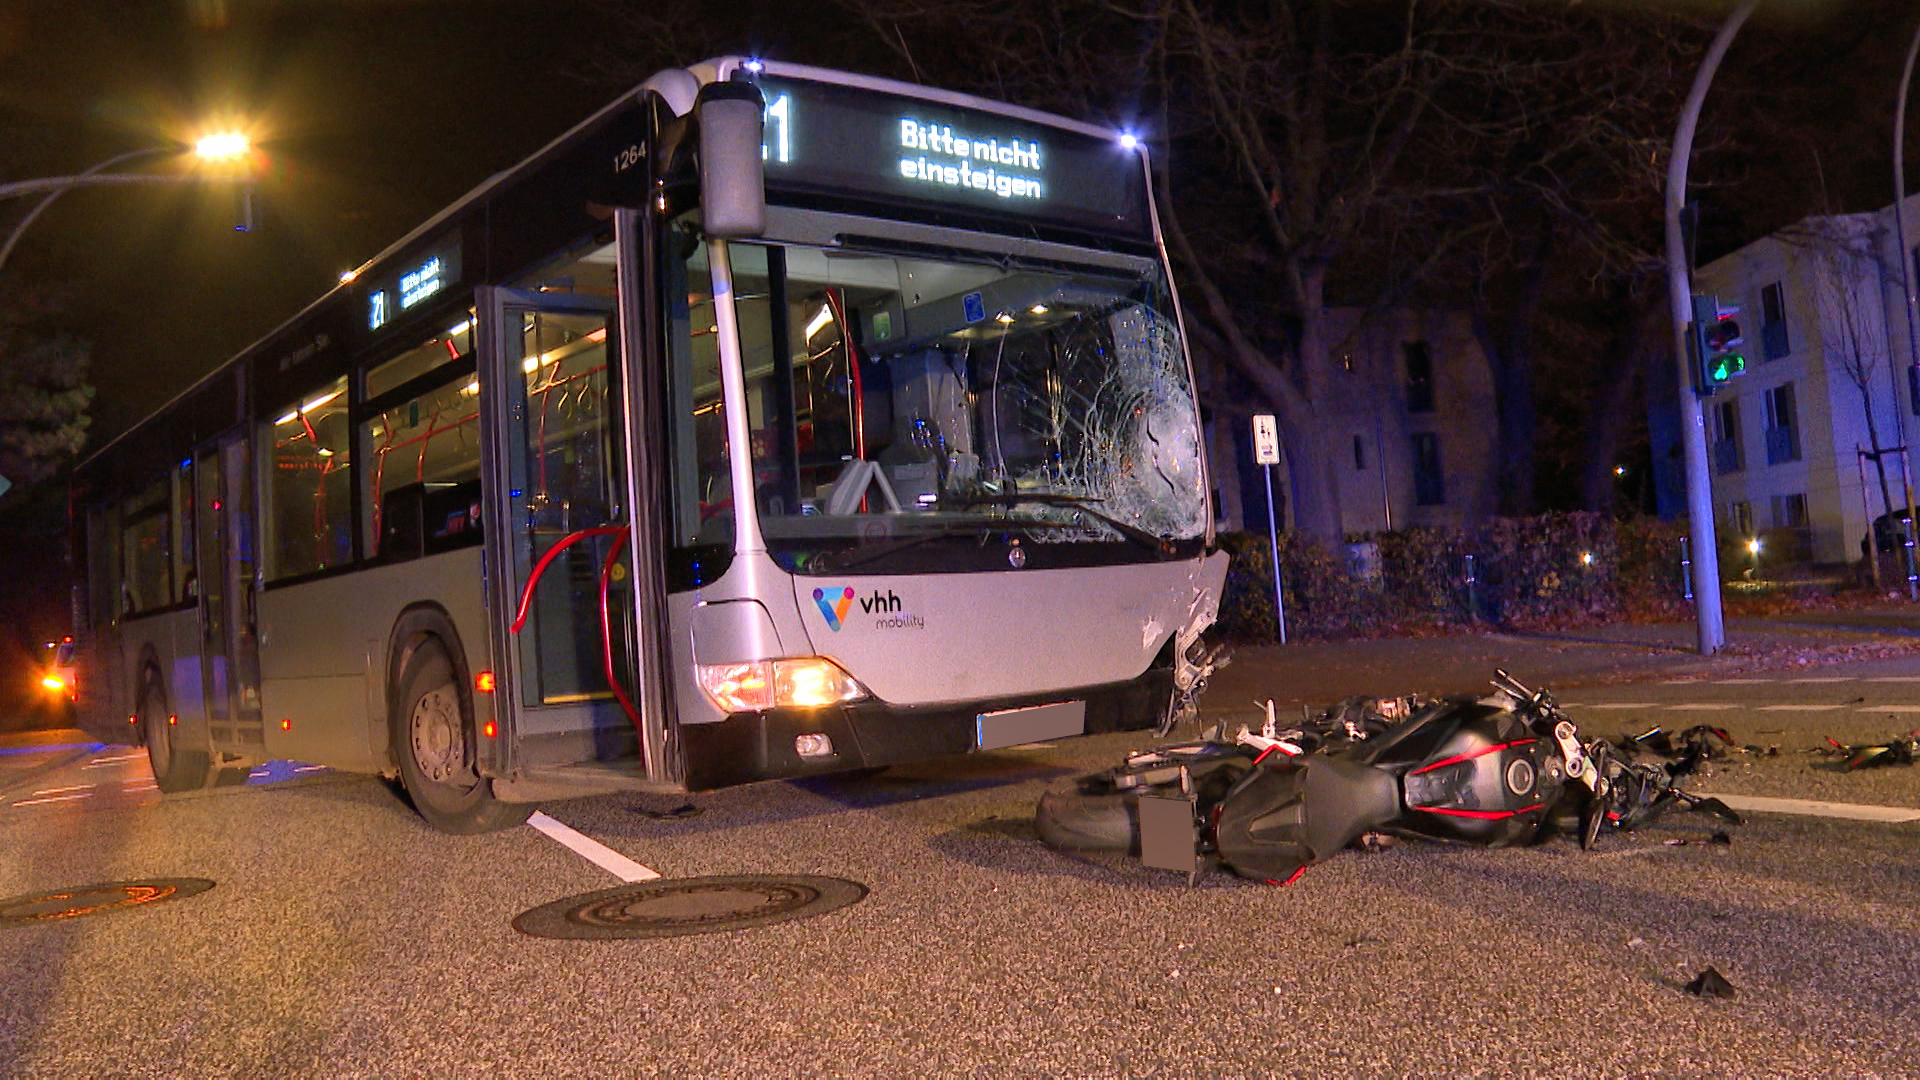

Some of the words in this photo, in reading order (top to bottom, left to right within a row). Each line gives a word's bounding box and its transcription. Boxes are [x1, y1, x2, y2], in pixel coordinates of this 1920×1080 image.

[762, 94, 789, 162] 1
[901, 118, 970, 158] Bitte
[973, 138, 1041, 170] nicht
[614, 140, 646, 173] 1264
[900, 156, 1041, 199] einsteigen
[370, 290, 385, 330] 21
[860, 589, 901, 614] vhh
[876, 614, 925, 629] mobility
